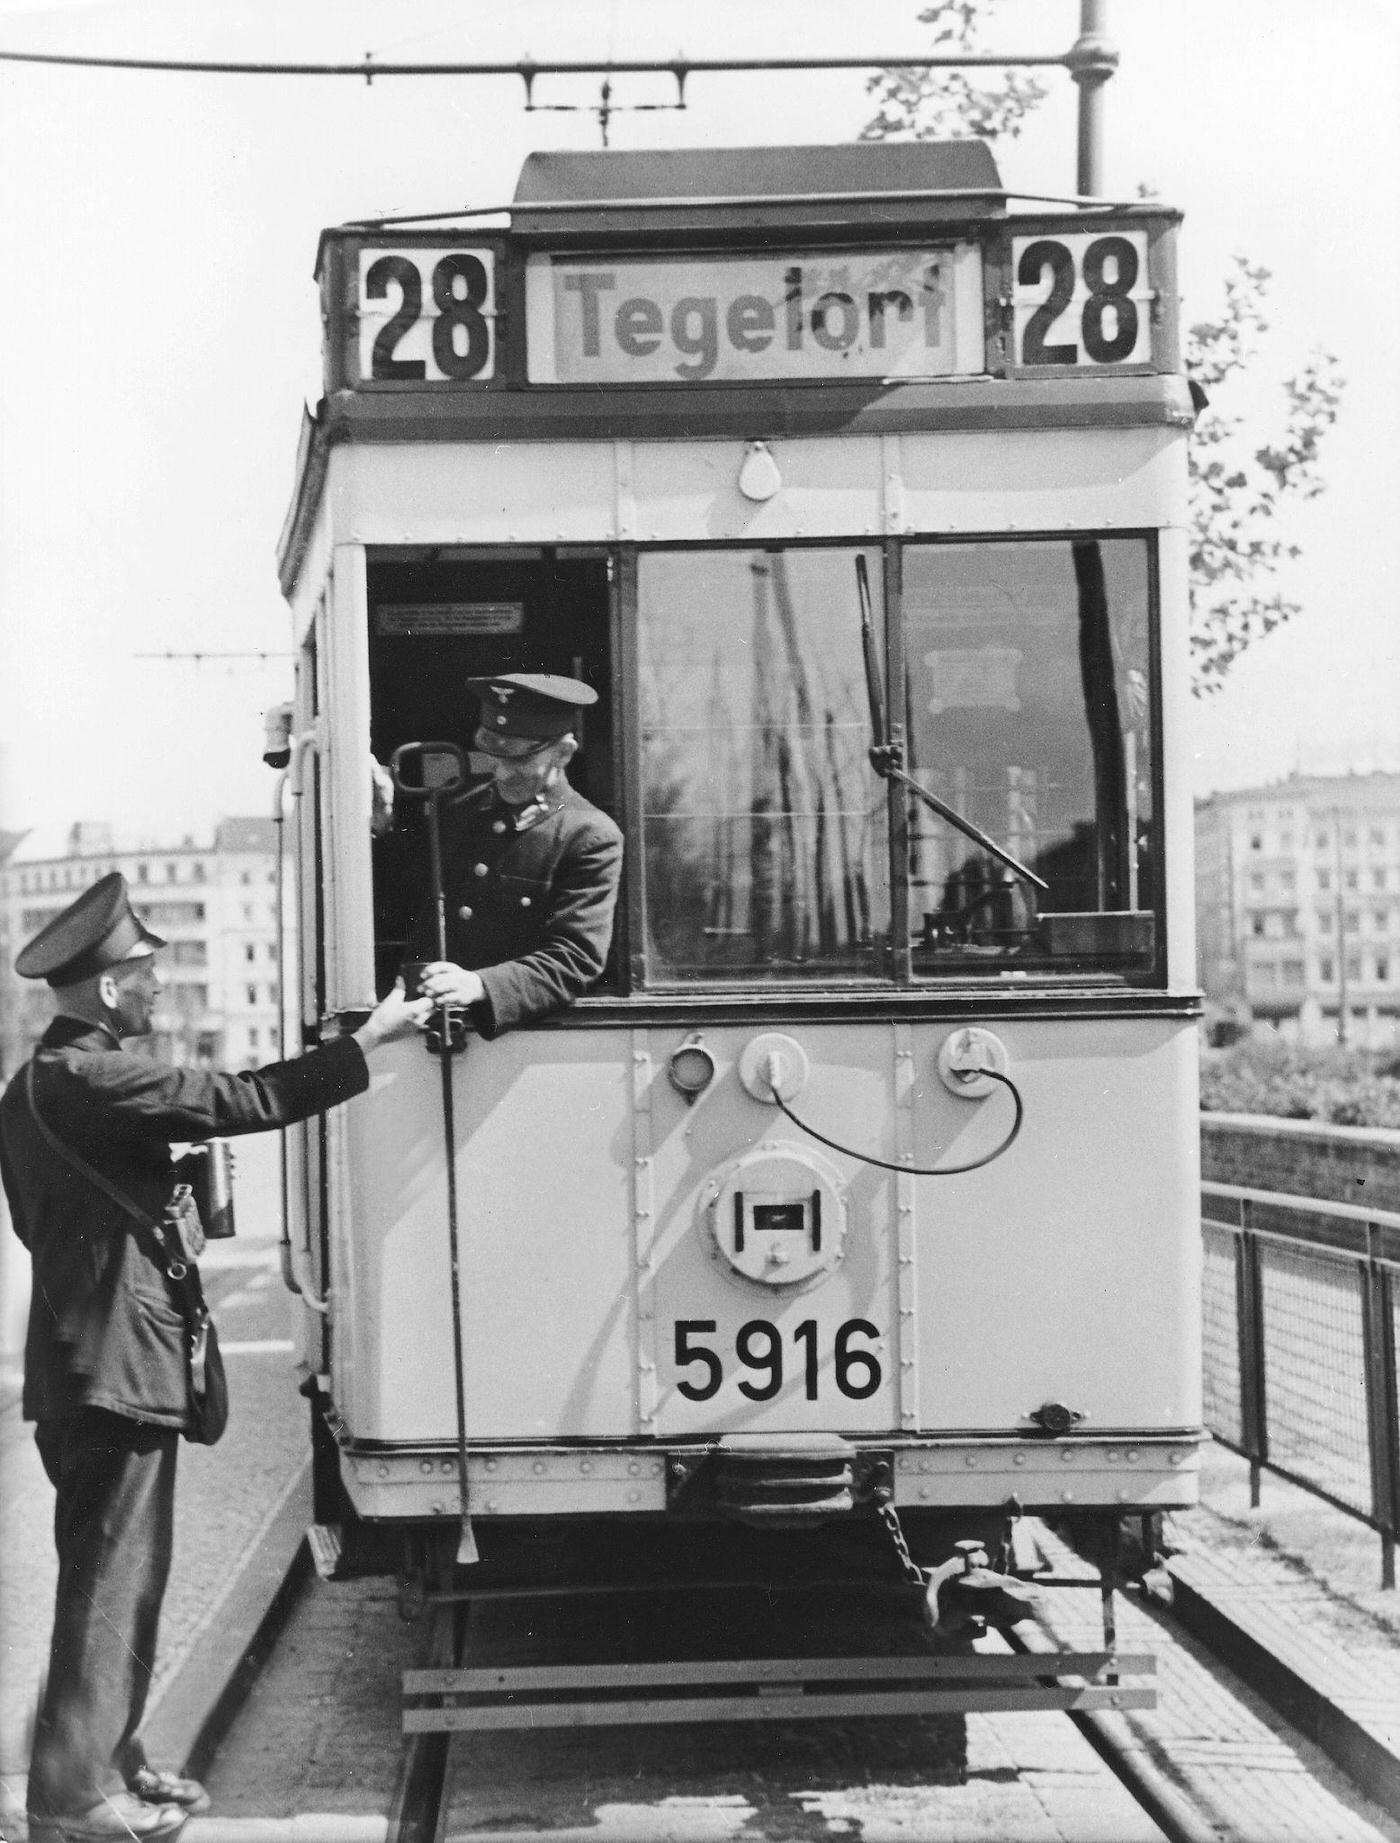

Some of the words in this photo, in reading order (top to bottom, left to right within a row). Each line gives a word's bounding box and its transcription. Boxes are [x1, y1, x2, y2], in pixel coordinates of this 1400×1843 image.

[366, 254, 489, 380] 28
[1018, 236, 1139, 365] 28
[674, 1318, 882, 1402] 5916
